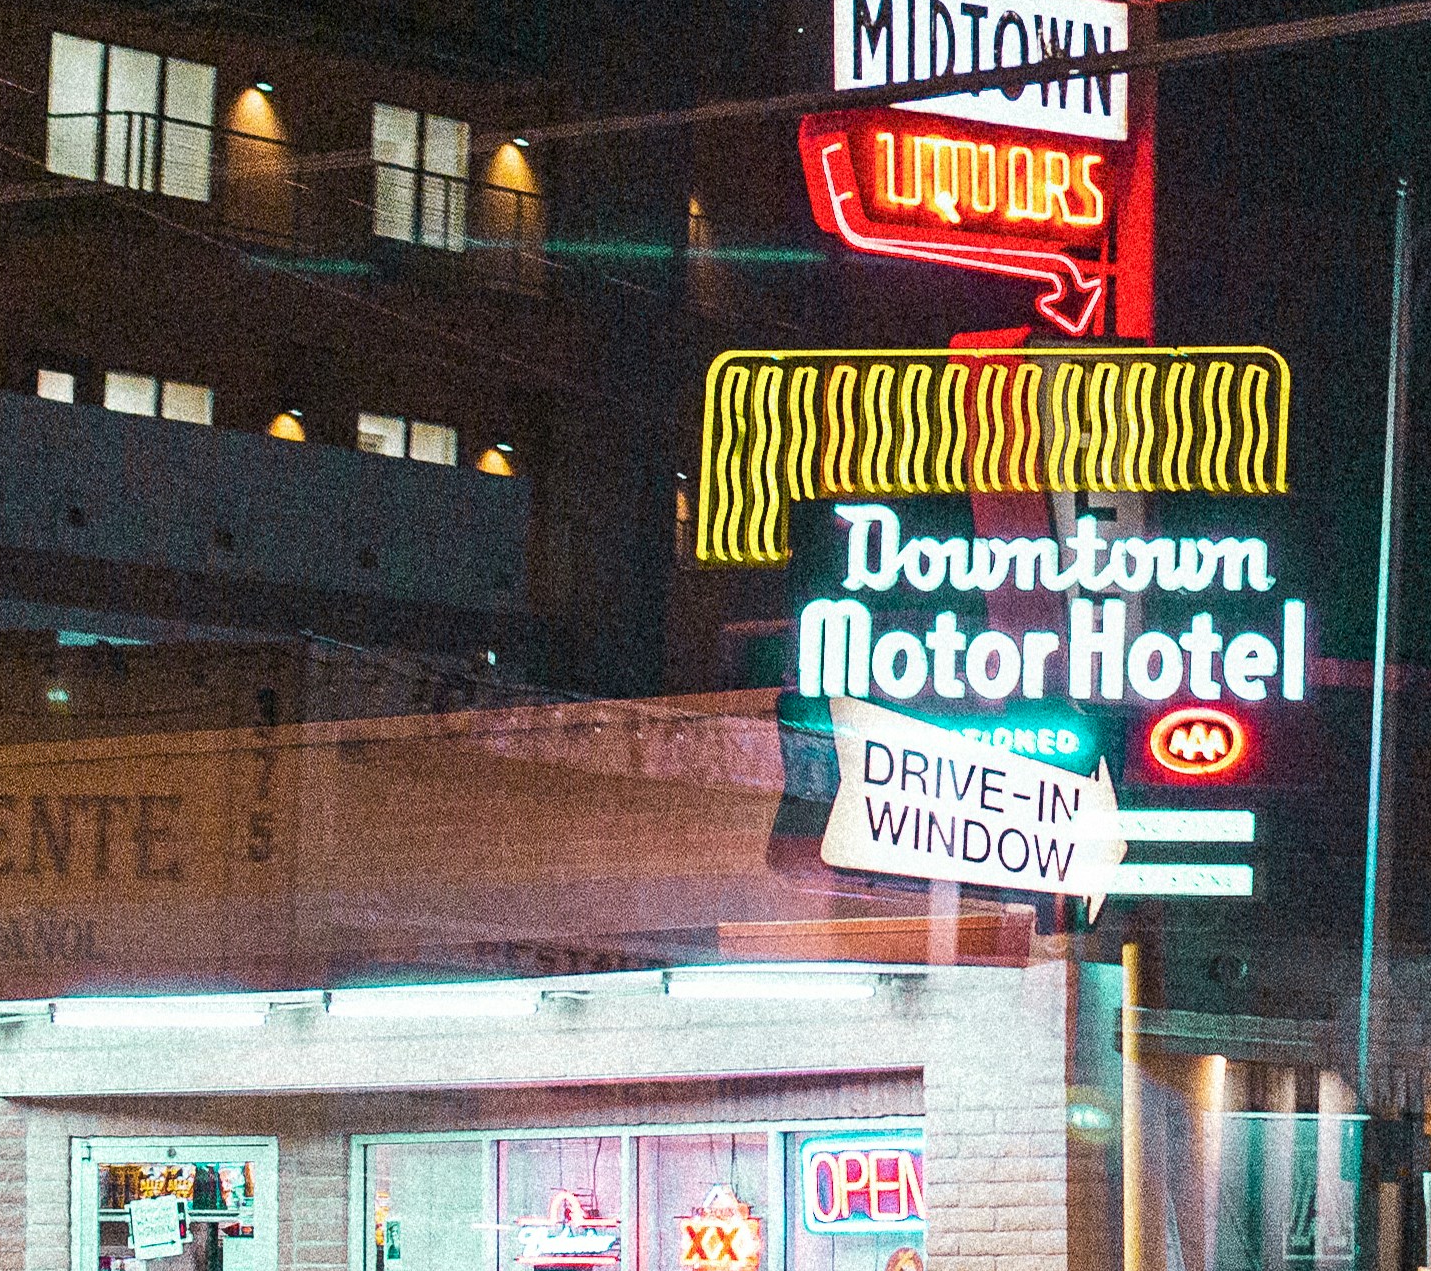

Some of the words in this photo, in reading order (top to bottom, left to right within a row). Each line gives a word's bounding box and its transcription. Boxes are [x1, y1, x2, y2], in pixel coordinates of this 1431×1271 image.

[876, 132, 1104, 226] LIQUORS
[834, 503, 1276, 594] Downtown
[798, 598, 1060, 701] Motor
[1068, 598, 1306, 702] Hotel
[863, 740, 1081, 823] DRIVE-IN
[1168, 722, 1226, 762] AAA
[865, 795, 1076, 883] WINDOW
[809, 1148, 926, 1223] OPEN
